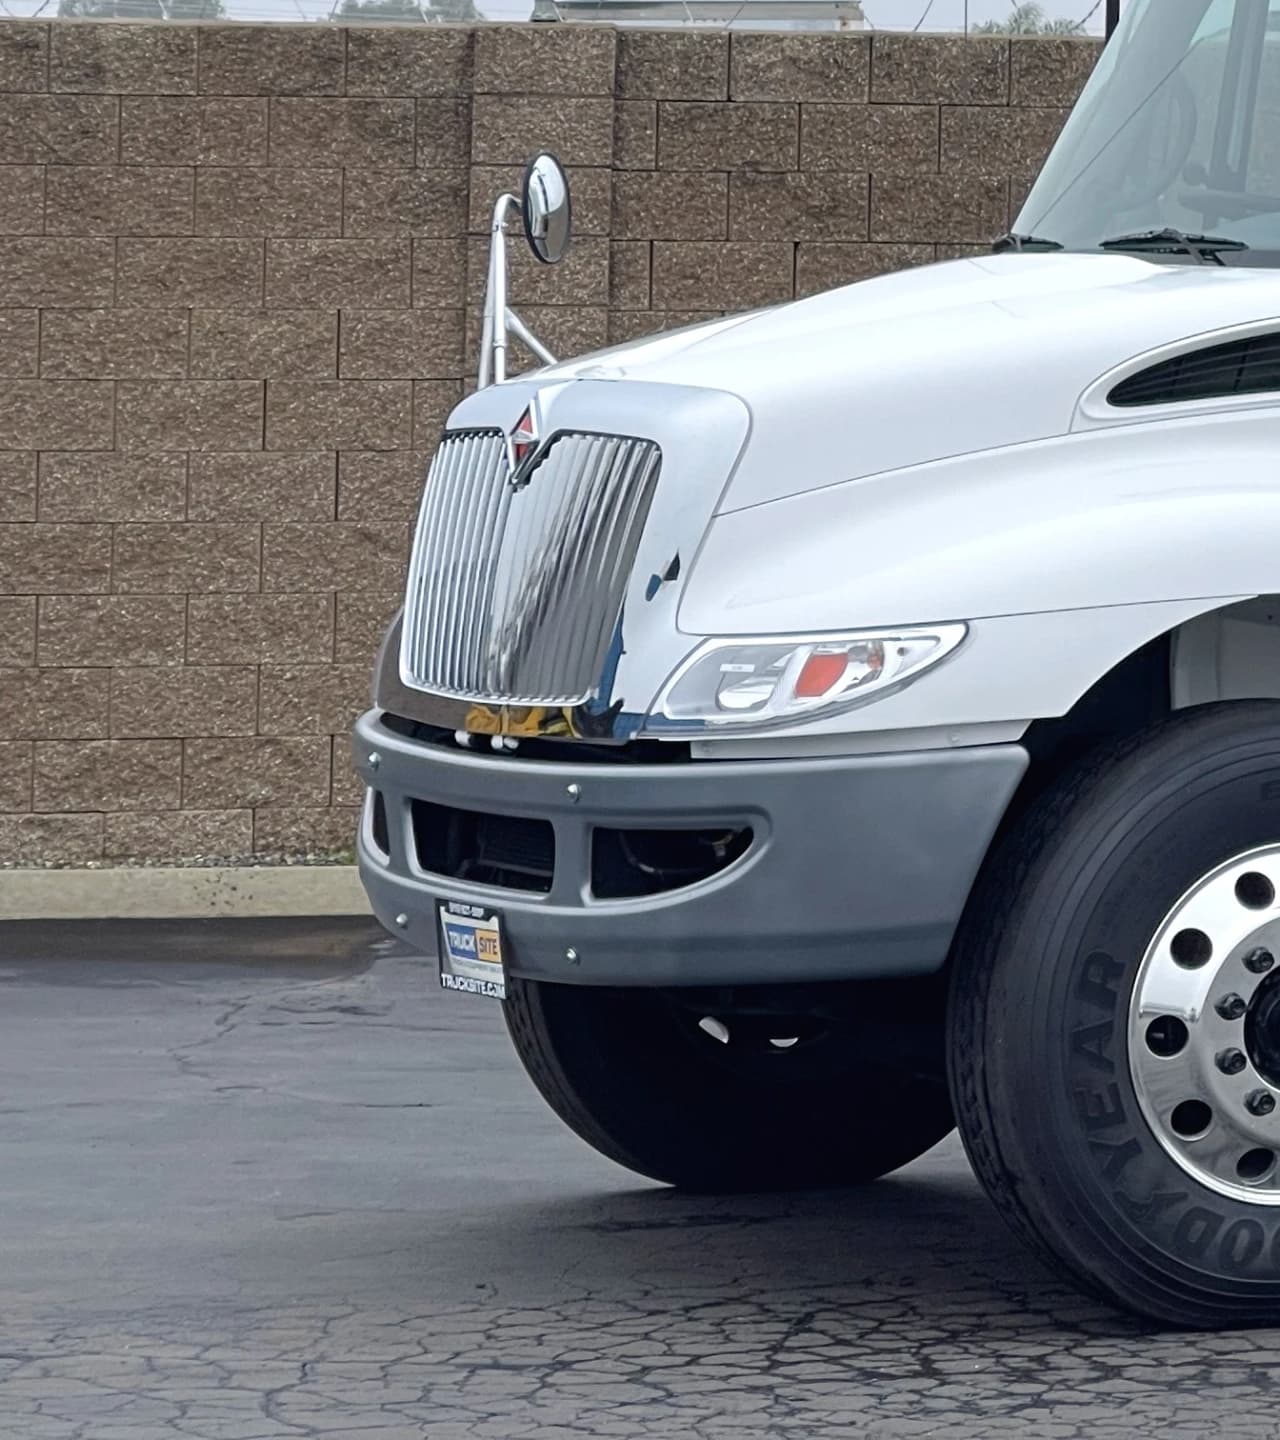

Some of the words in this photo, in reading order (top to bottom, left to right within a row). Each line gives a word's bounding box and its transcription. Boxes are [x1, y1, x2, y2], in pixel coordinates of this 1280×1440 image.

[448, 930, 476, 953] TRUCK
[479, 937, 498, 955] SITE
[441, 973, 506, 1000] TRUCKSITE.COM
